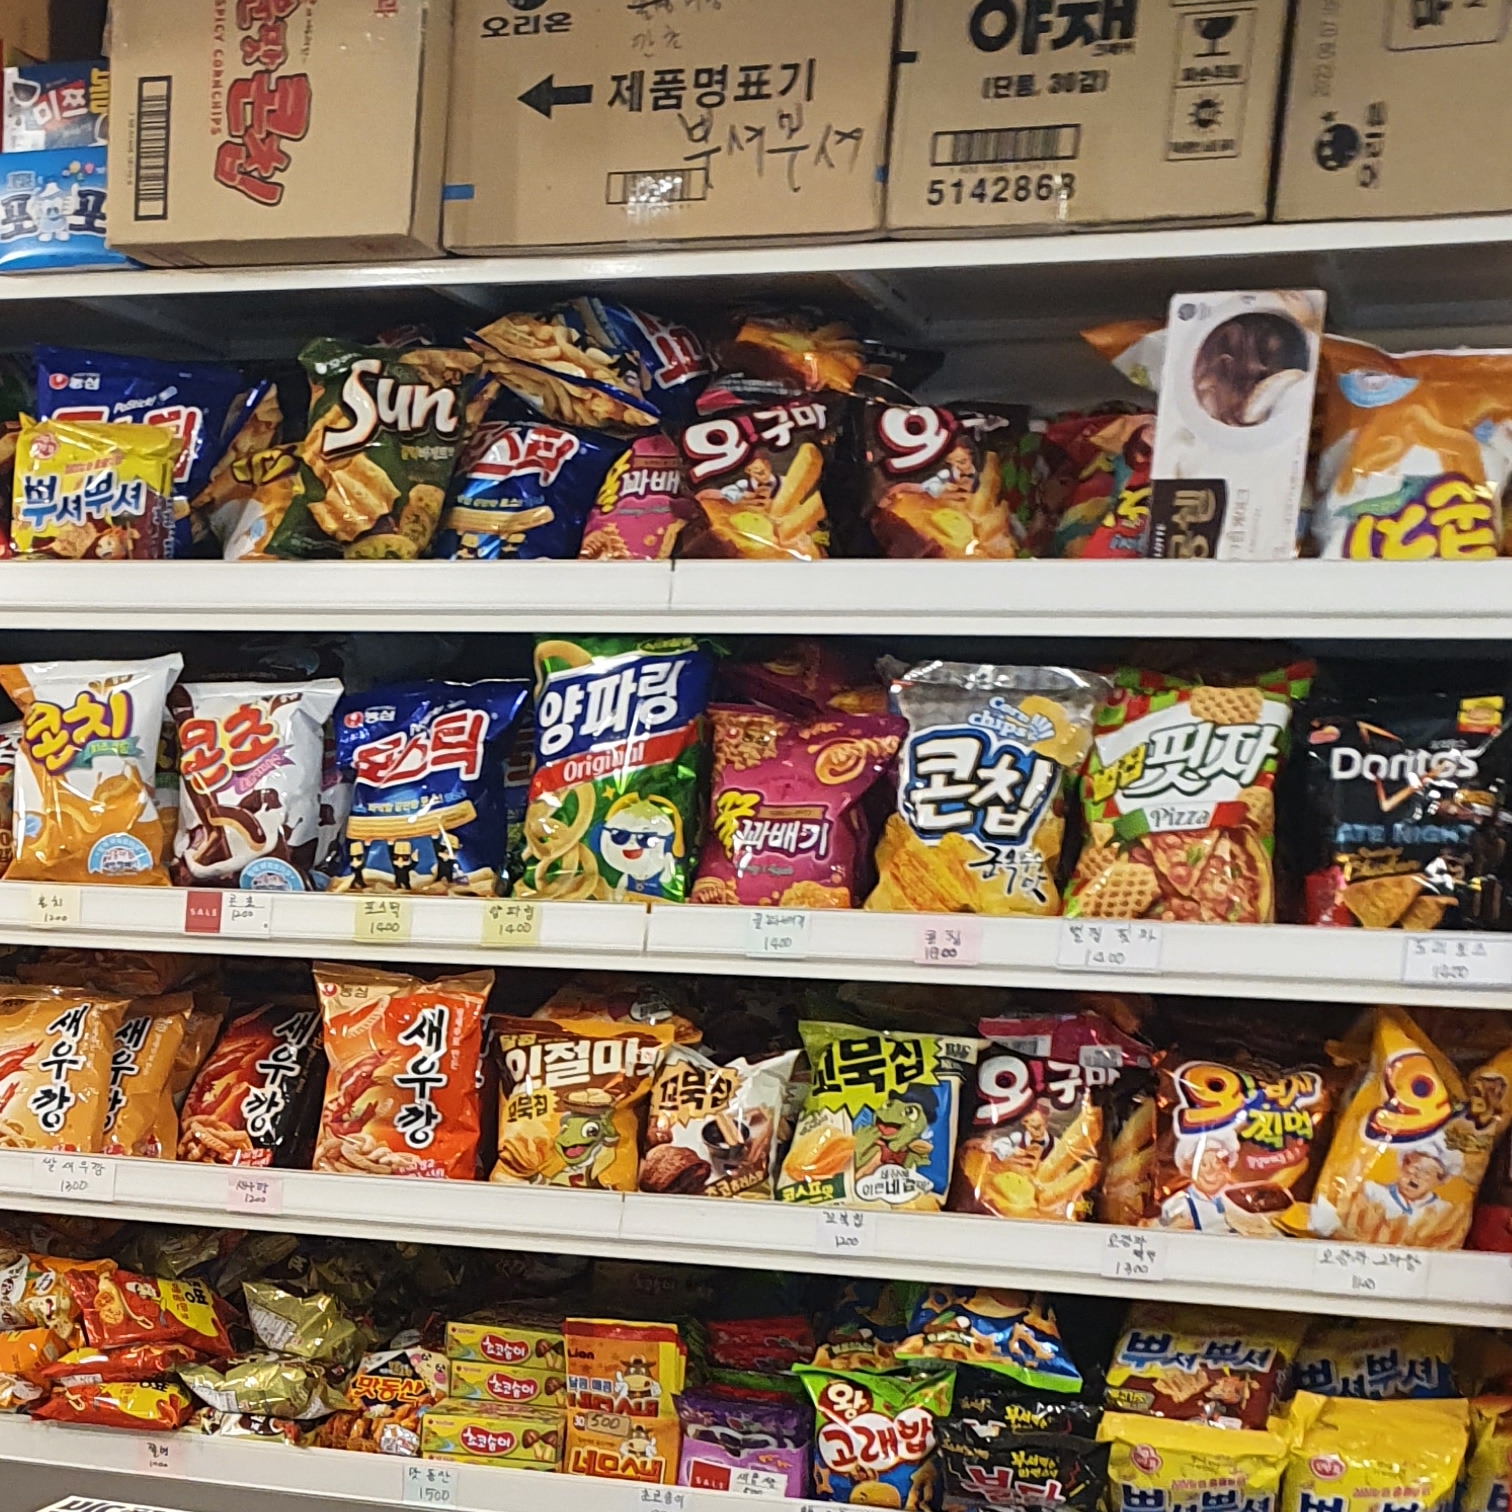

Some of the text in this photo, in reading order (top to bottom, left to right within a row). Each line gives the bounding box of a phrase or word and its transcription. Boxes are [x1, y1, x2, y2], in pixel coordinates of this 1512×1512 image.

[480, 14, 573, 38] 오리온
[608, 58, 818, 114] 제품명표기
[214, 72, 312, 206] 콘칩
[321, 358, 458, 460] Sun
[19, 476, 145, 532] 뿌셔뿌셔
[363, 708, 396, 724] 농심
[540, 659, 680, 756] 양파링
[967, 712, 1025, 740] chips
[24, 690, 134, 776] 콘치
[179, 702, 282, 790] 콘초
[353, 709, 490, 788] 포스틱
[1123, 722, 1285, 798] 핏자
[1330, 744, 1483, 781] Doritos
[908, 729, 1058, 839] 콘칩
[1150, 805, 1210, 828] Pizza
[736, 818, 832, 856] 꽈배기
[188, 906, 218, 918] SALE
[369, 920, 401, 935] 1400
[498, 920, 532, 935] 1400
[27, 1004, 90, 1133] 새우깡
[240, 1009, 321, 1140] 새우깡
[394, 1004, 450, 1149] 새우깡
[812, 1038, 925, 1096] 꼬북칩
[658, 1067, 737, 1113] 꼬북칩
[834, 1235, 859, 1248] 1200
[479, 1335, 529, 1360] 초코송이
[568, 1348, 595, 1360] Lion
[1124, 1332, 1273, 1371] 뿌셔뿌셔
[349, 1375, 426, 1402] 맛동산
[488, 1373, 537, 1397] 초코송이
[827, 1384, 865, 1420] 왕
[462, 1427, 515, 1451] 초코송이
[588, 1413, 621, 1430] 500
[821, 1410, 934, 1470] 고래밥
[417, 1487, 451, 1503] 1500
